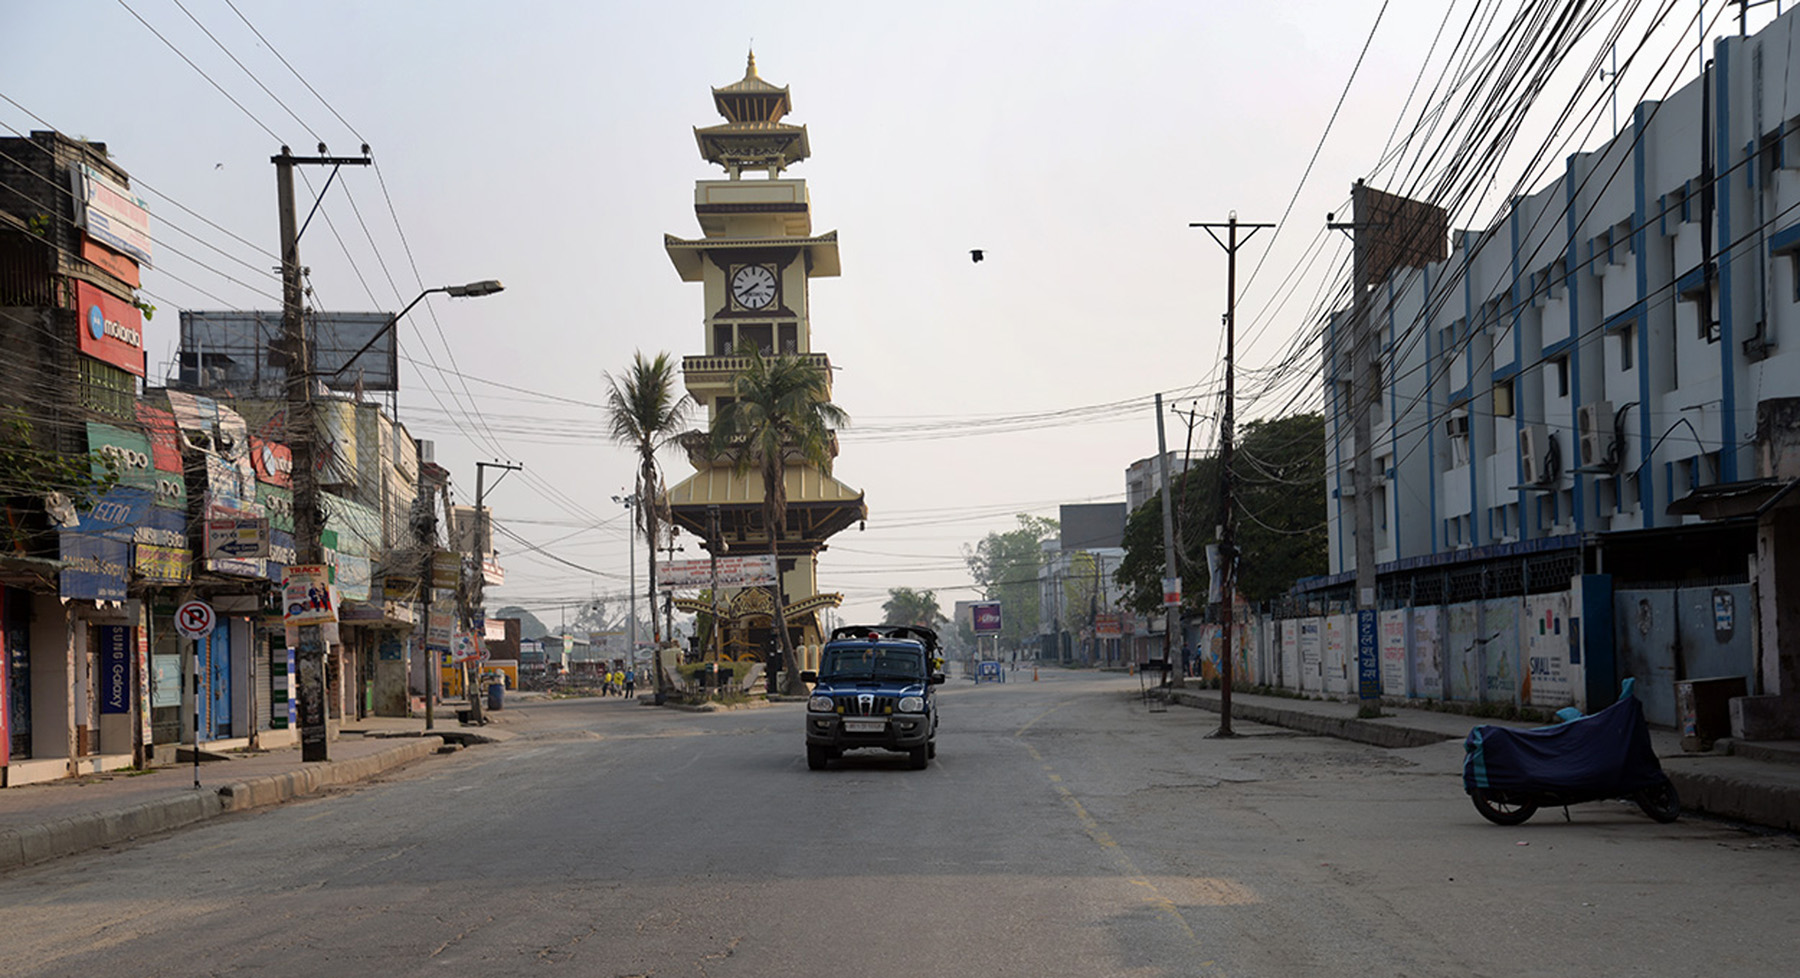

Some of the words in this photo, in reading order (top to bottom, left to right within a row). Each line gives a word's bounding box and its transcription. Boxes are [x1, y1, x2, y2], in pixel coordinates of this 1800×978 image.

[103, 320, 141, 348] motorola
[289, 566, 321, 574] TRACK
[109, 663, 124, 708] Galaxy
